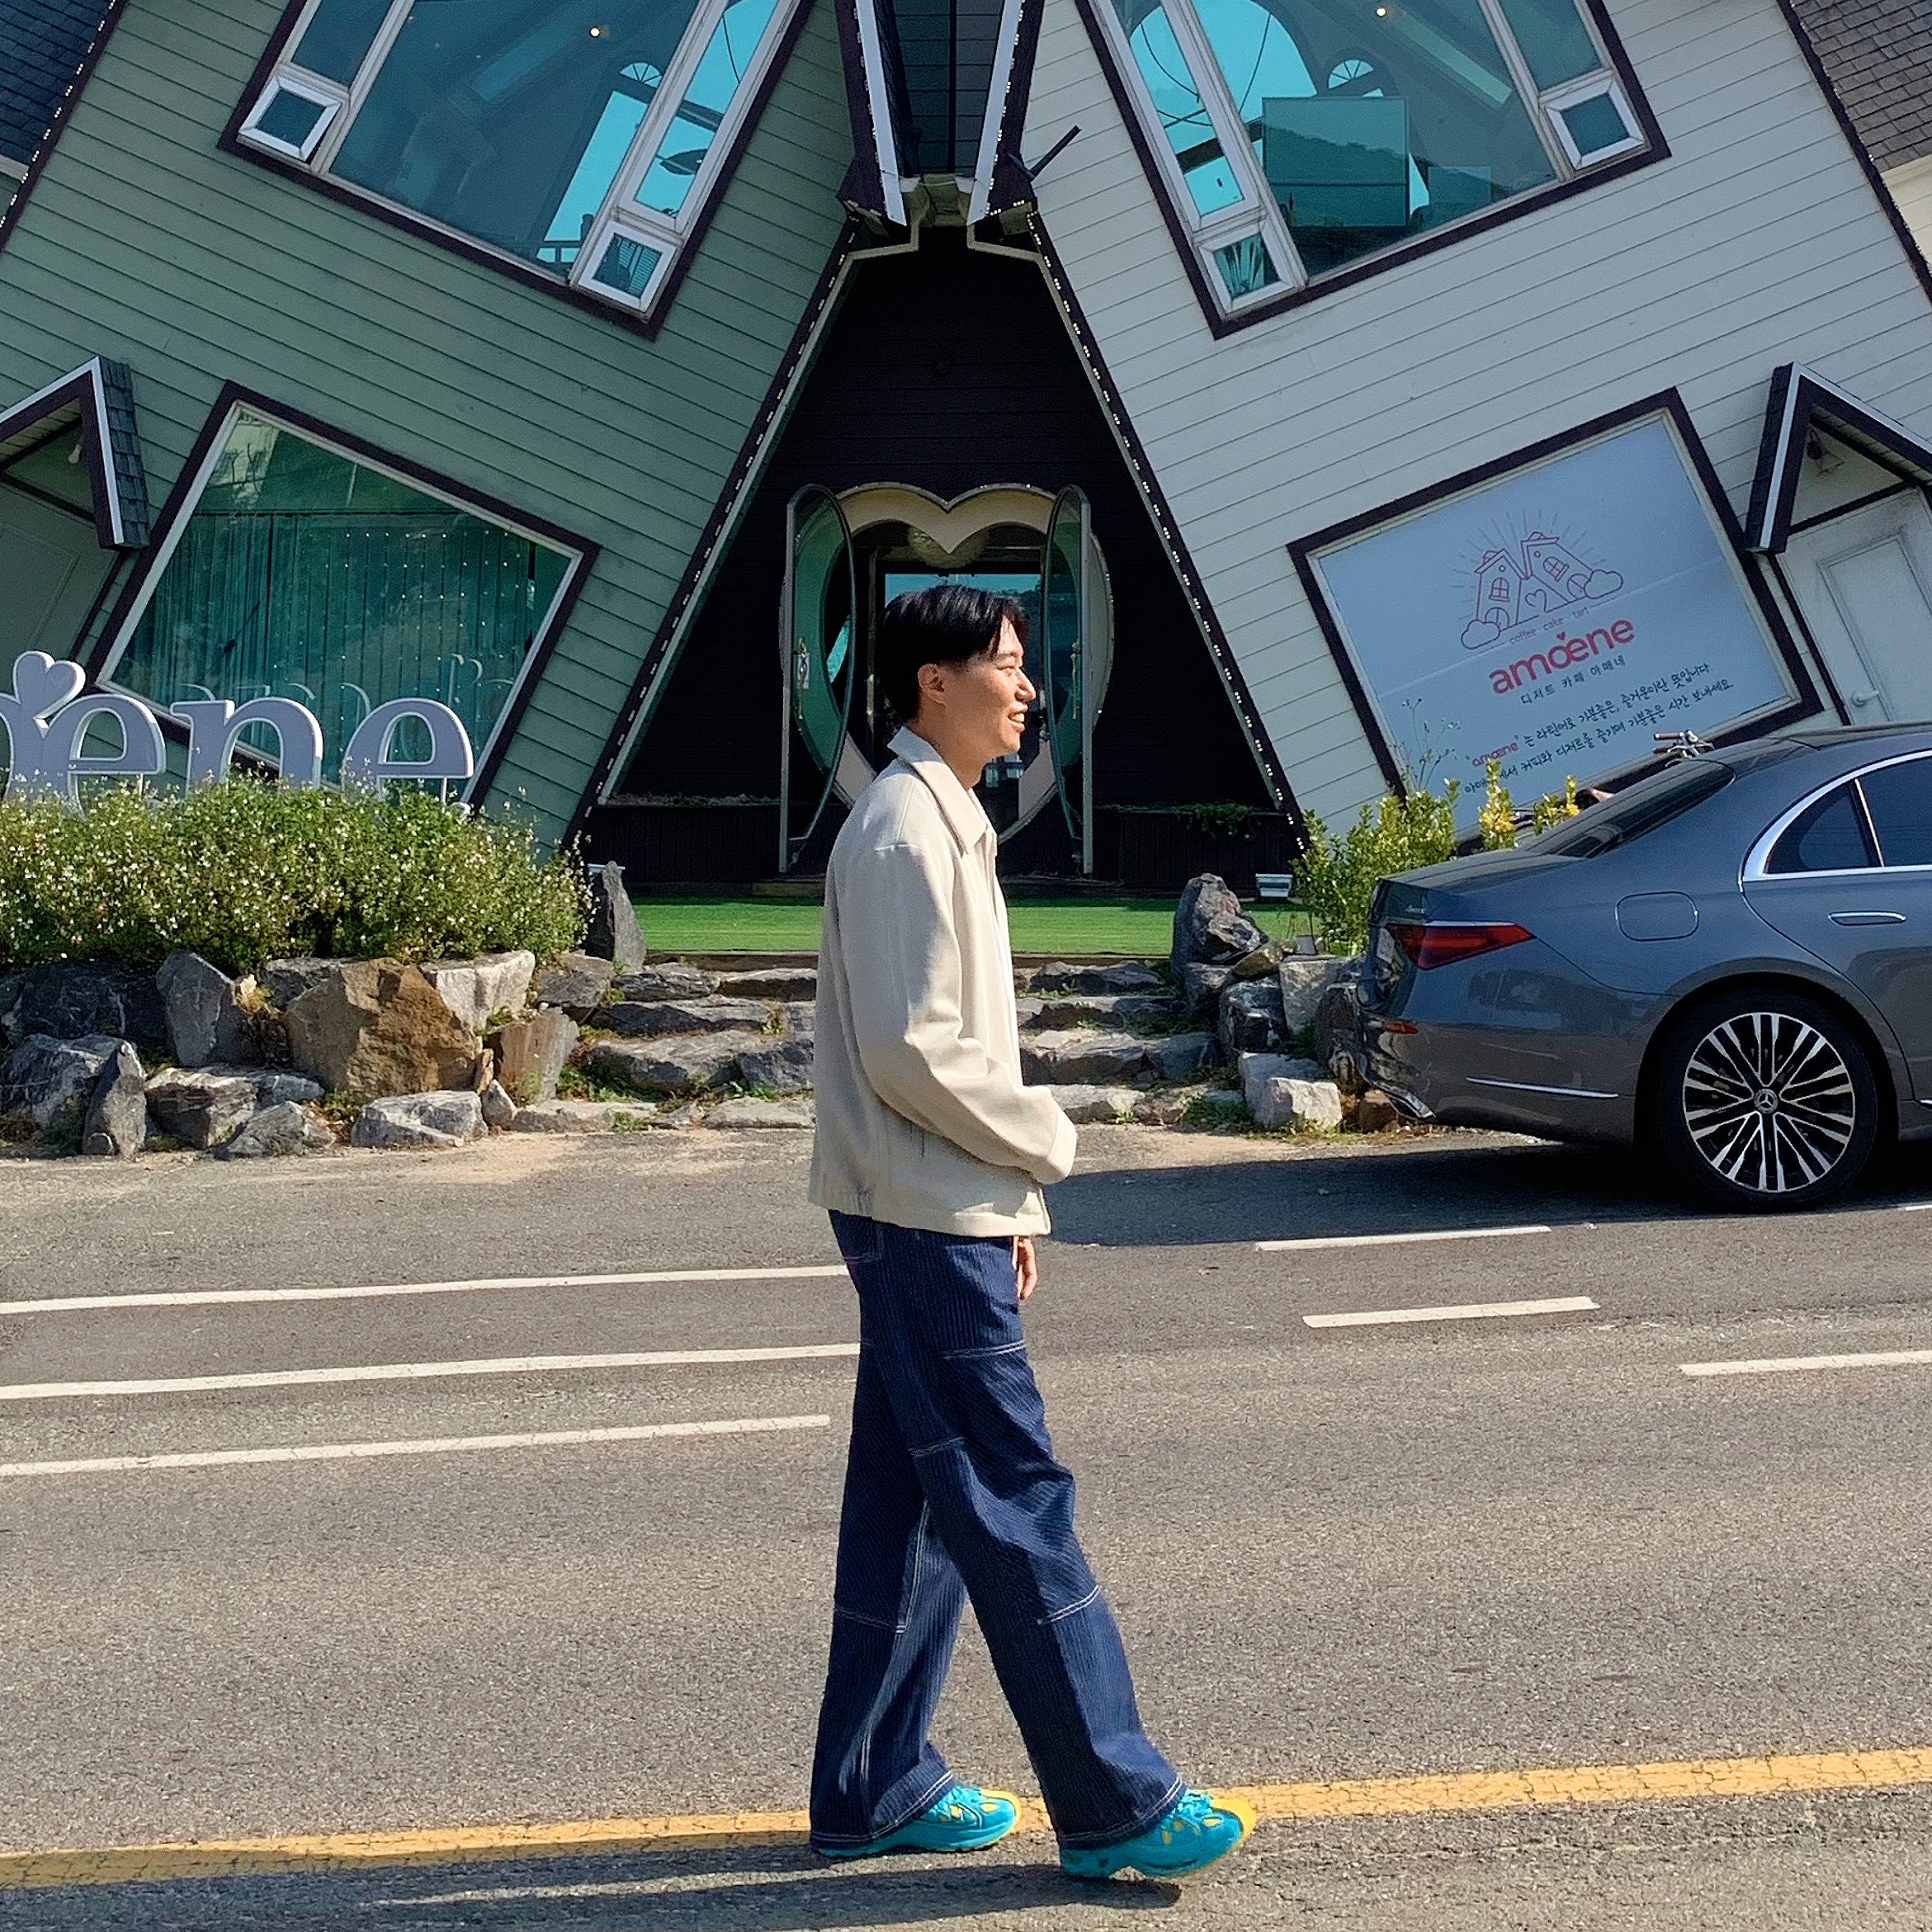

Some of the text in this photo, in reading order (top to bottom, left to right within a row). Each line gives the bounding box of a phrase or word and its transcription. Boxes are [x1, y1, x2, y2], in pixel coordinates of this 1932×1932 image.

[1509, 607, 1590, 645] coffee cake tart
[1520, 654, 1627, 704] 디저트 카페 아매네
[1520, 749, 1552, 771] 커피와
[1556, 732, 1594, 756] 디저트를
[1595, 720, 1627, 744] 즐기며
[1628, 704, 1665, 727] 기분좋은
[1668, 695, 1691, 711] 시간
[1536, 717, 1576, 740] 라틴어로
